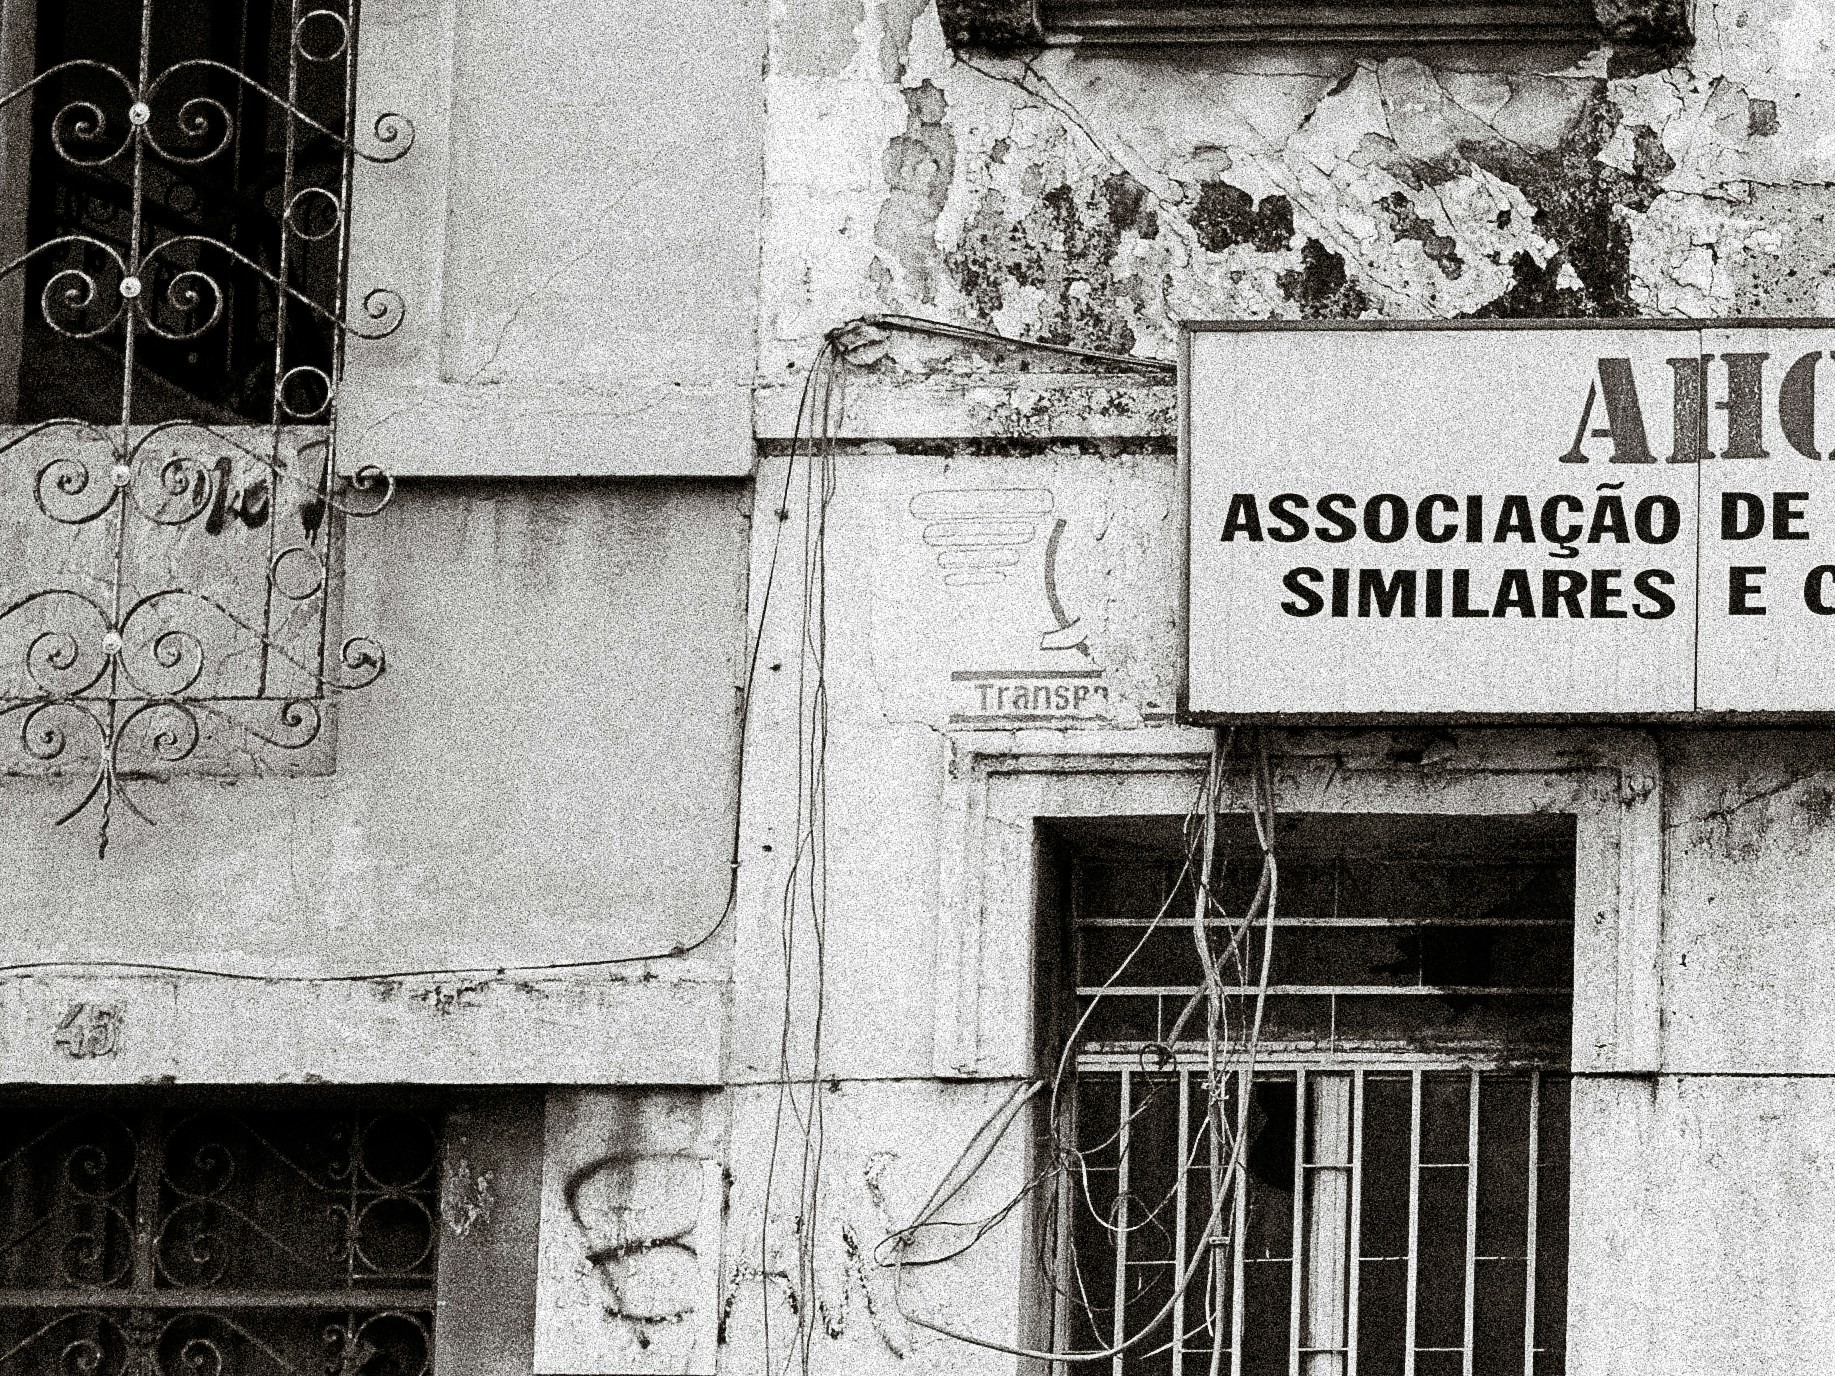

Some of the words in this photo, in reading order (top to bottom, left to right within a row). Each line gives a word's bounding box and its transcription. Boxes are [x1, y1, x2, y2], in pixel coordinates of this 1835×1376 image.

[1220, 482, 1681, 559] ASSOCIAÇÃO
[1720, 491, 1810, 541] DE
[1280, 566, 1677, 620] SIMILARES
[1728, 565, 1767, 616] E
